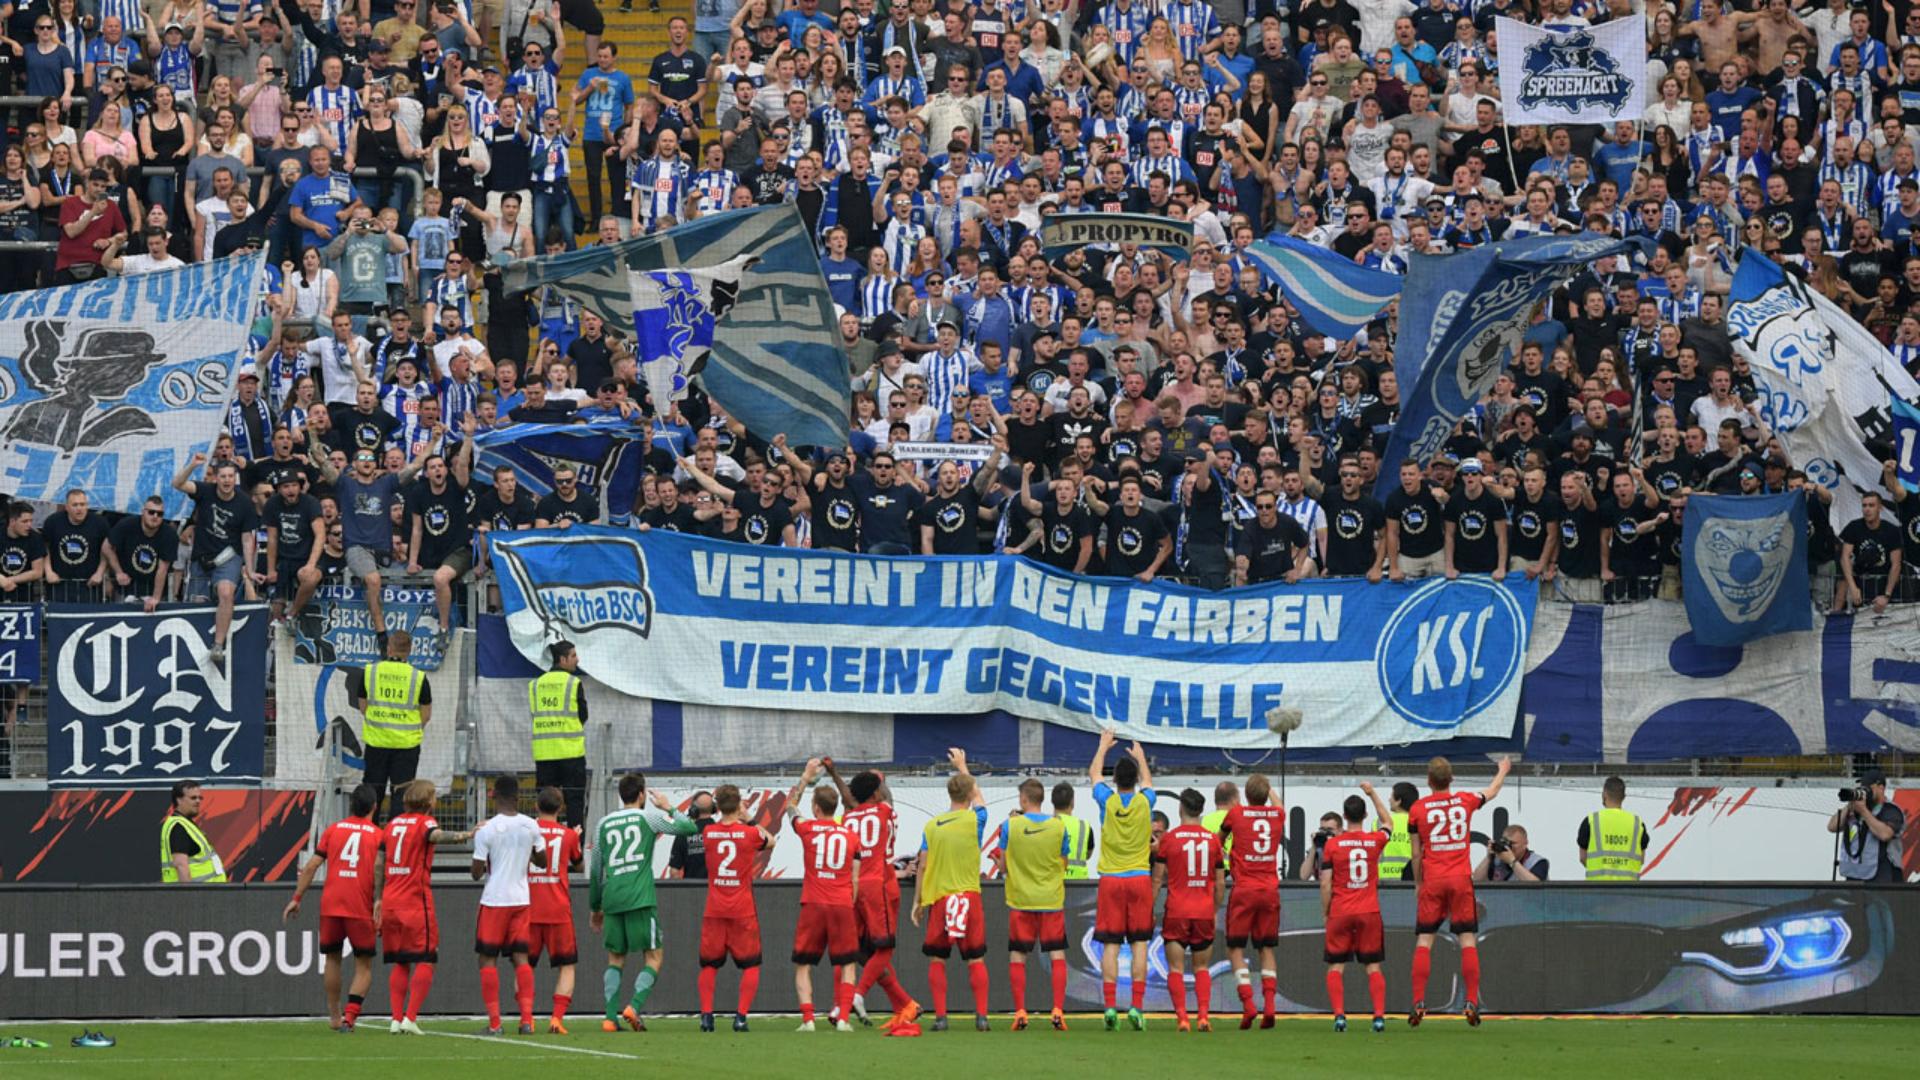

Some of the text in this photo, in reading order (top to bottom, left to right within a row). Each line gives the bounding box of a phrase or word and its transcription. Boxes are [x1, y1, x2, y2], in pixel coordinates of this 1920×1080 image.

[1527, 74, 1618, 96] SPREEMACHT
[1197, 153, 1213, 165] DB
[657, 179, 672, 192] DB
[1071, 223, 1188, 247] PROPYRO
[384, 589, 437, 603] BOYS
[692, 550, 1343, 645] VEREINT IN DEN FARBEN
[1411, 604, 1495, 696] KSC
[380, 687, 404, 699] 1014
[541, 696, 559, 707] 960
[720, 640, 1284, 731] VEREINT GEGEN ALLE
[60, 717, 242, 776] 1997
[1253, 818, 1271, 854] 3
[1427, 806, 1468, 842] 28
[340, 831, 361, 868] 4
[392, 825, 408, 864] 7
[606, 825, 645, 867] 22
[717, 839, 737, 876] 2
[812, 832, 848, 870] 10
[1182, 839, 1209, 877] 11
[1349, 848, 1368, 882] 6
[0, 932, 126, 978] LER
